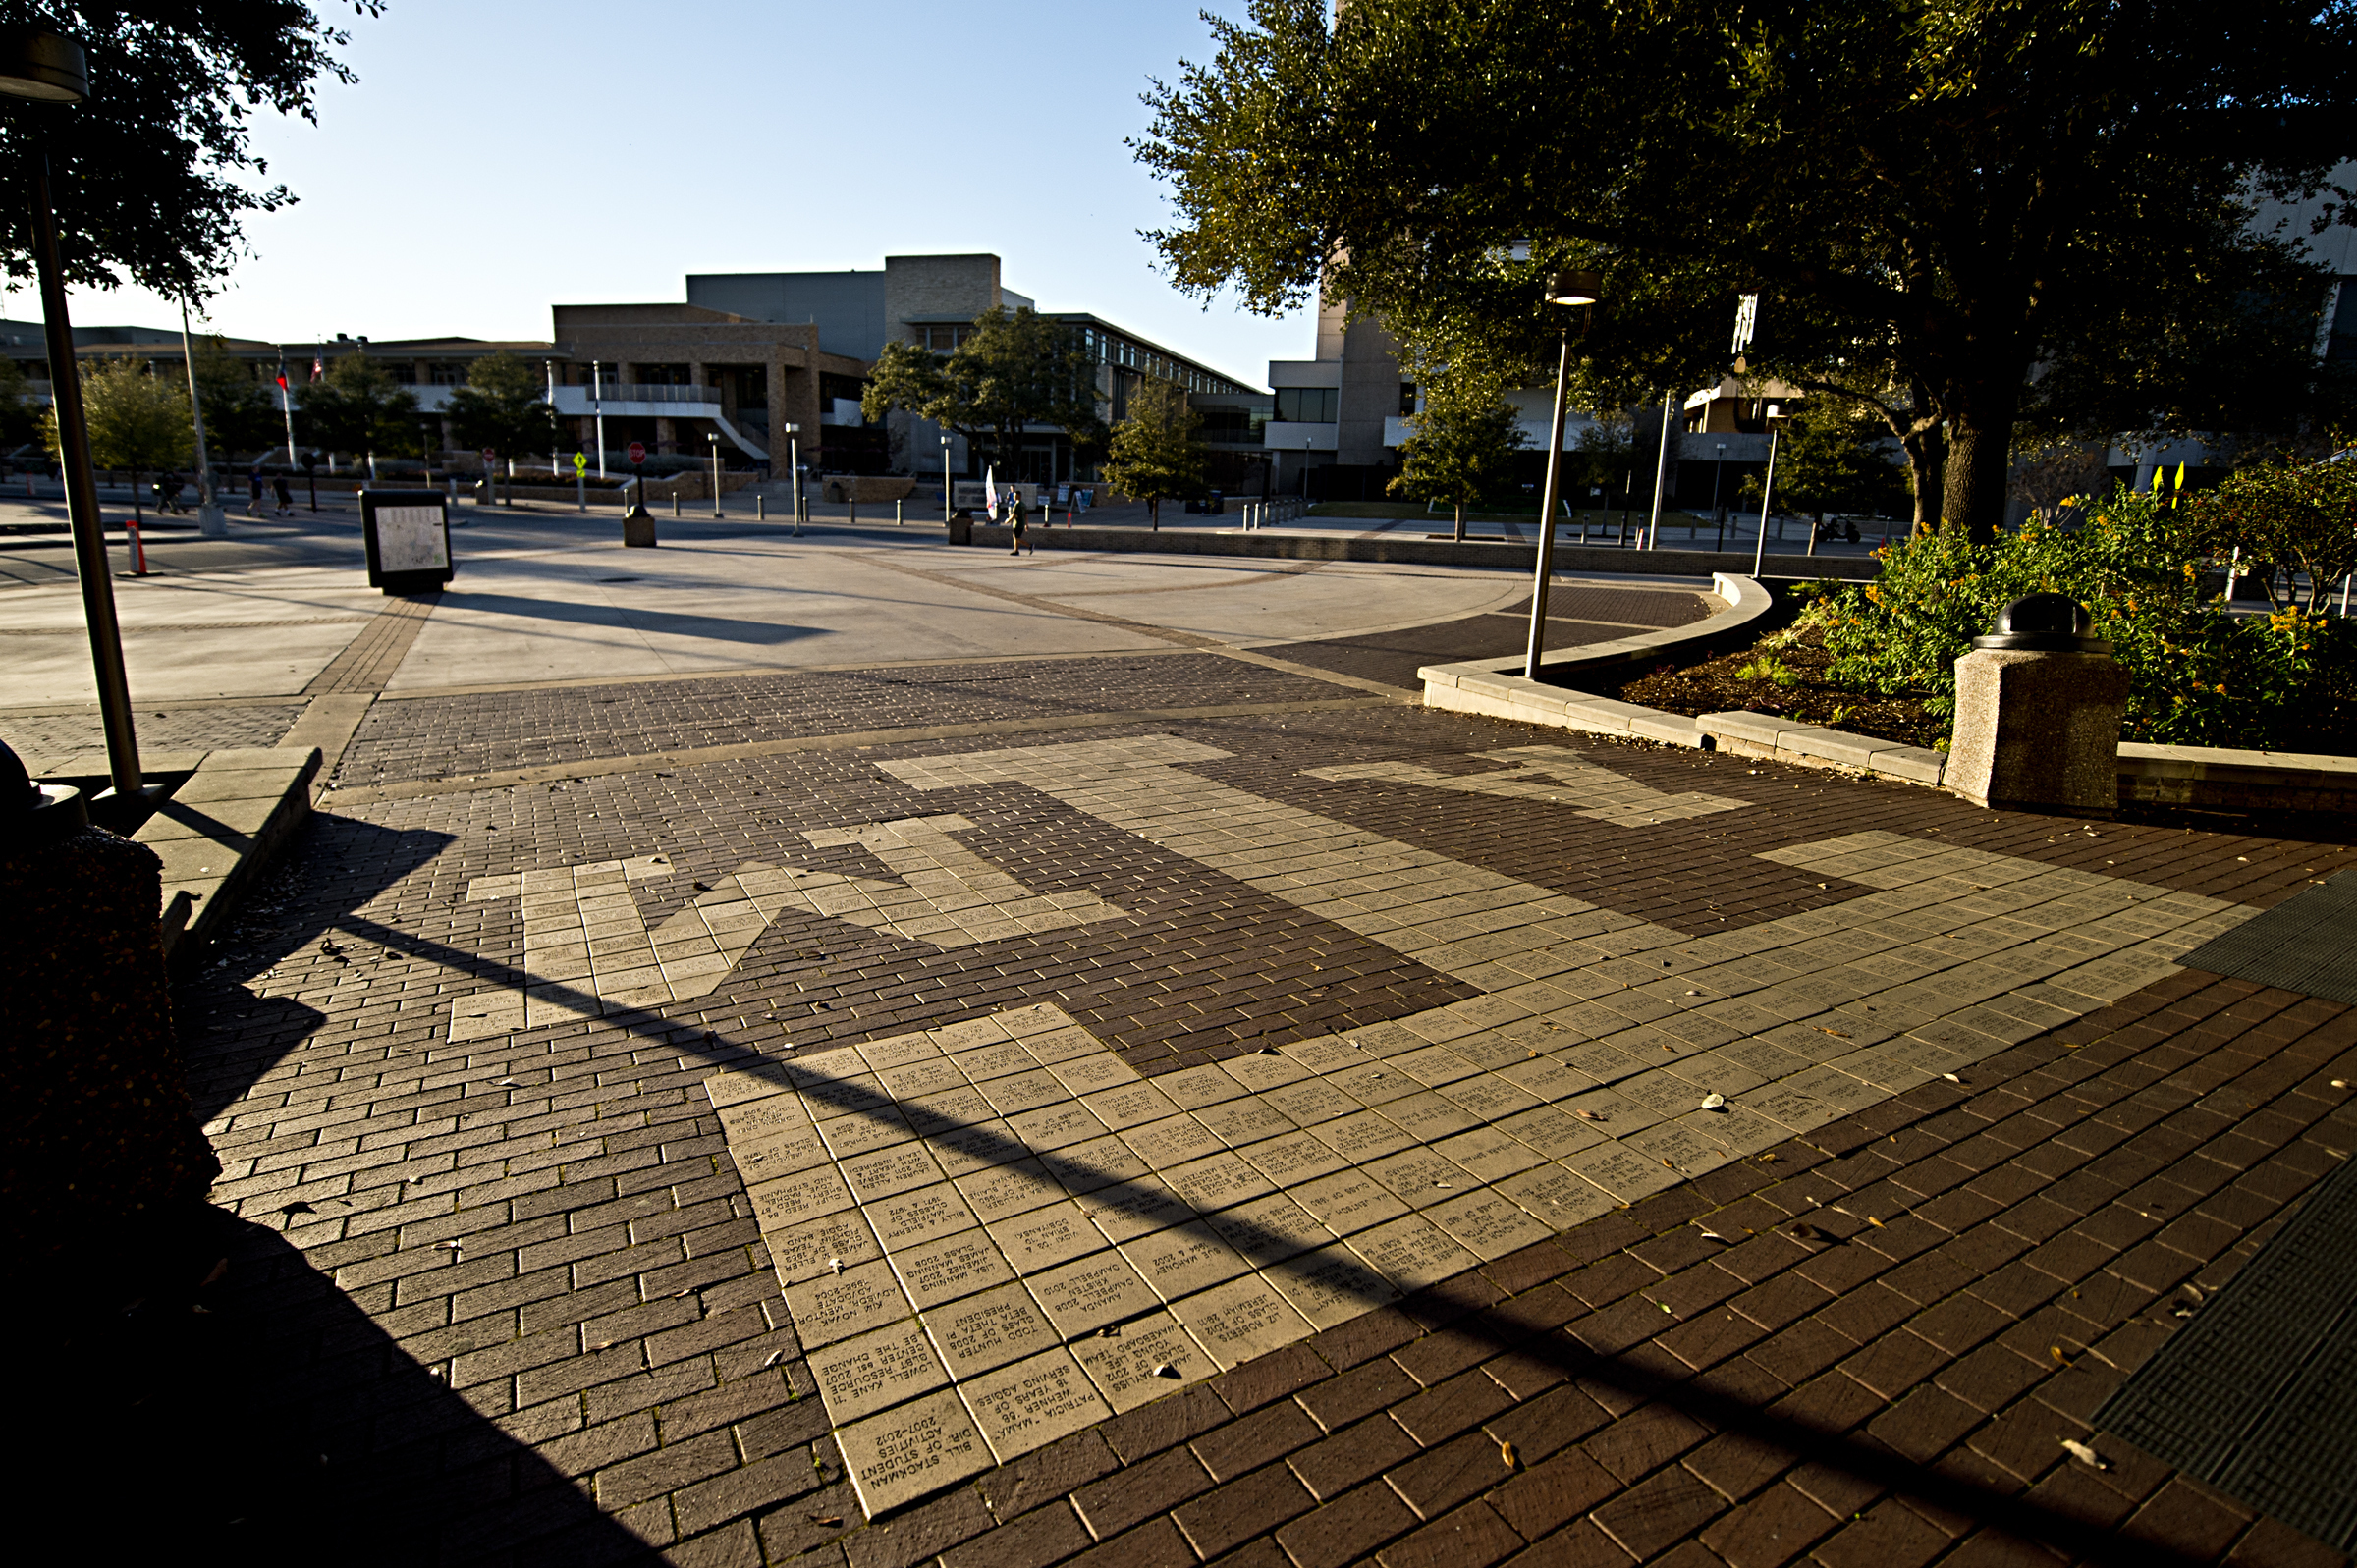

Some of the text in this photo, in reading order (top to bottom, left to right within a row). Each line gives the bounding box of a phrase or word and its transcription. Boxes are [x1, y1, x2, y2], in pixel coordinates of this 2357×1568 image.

[896, 1149, 922, 1161] LEAVE
[900, 1156, 921, 1166] WITH
[861, 1166, 930, 1190] LAUREN ALLEN
[867, 1162, 896, 1175] HEART
[893, 1165, 912, 1174] 2011
[758, 1174, 833, 1201] AND STEPHANIE
[764, 1190, 801, 1205] RACHEL
[806, 1185, 842, 1200] SHERYL
[814, 1193, 841, 1206] CLIFF
[1139, 1186, 1166, 1199] JASON
[776, 1197, 801, 1210] REED
[784, 1202, 809, 1214] REED
[888, 1205, 907, 1216] 1972
[889, 1201, 948, 1223] CLASSES OF
[922, 1195, 941, 1205] 1971
[1107, 1199, 1176, 1225] SANDRA ERWIN
[1135, 1197, 1159, 1208] MOM
[899, 1209, 945, 1227] MAYFIELD
[940, 1210, 965, 1222] BILLY
[786, 1222, 849, 1246] AGGIE BAND
[831, 1234, 862, 1249] CLASS
[886, 1222, 924, 1239] SHERRY
[1023, 1225, 1069, 1245] BRIAN '10
[1054, 1230, 1080, 1243] VICKI
[781, 1241, 813, 1255] TEXAS
[812, 1245, 826, 1255] OF
[835, 1240, 868, 1255] JAMES
[913, 1243, 974, 1267] CLASS 2008
[1187, 1241, 1209, 1253] 1994
[783, 1256, 816, 1271] ELLER
[905, 1246, 990, 1278] JAMES MANNING
[918, 1256, 988, 1283] JIMENEZ 2007
[1151, 1253, 1176, 1266] 2002
[1153, 1246, 1221, 1275] SUE MAHONEY
[920, 1262, 996, 1292] LISA MANNING
[1042, 1263, 1120, 1295] CAMPBELL 2010
[1067, 1276, 1109, 1297] KRISTEN
[816, 1285, 872, 1309] ADVOCATE
[1053, 1277, 1134, 1312] CAMPBELL 2008
[1079, 1292, 1122, 1313] AMANDA
[1221, 1293, 1269, 1317] JEREMIAH
[796, 1304, 844, 1325] MENTOR
[820, 1300, 883, 1326] KIM NOVAK
[944, 1306, 1027, 1340] BETA THETA PI
[954, 1302, 1011, 1327] PRESIDENT
[1203, 1301, 1279, 1335] CLASS OF 2012
[948, 1314, 1035, 1350] CLASS OF 2008
[1216, 1311, 1283, 1343] LIZ ROBERTS
[879, 1342, 924, 1365] CENTER
[957, 1325, 1038, 1359] TODD HUNTER
[1082, 1324, 1175, 1367] WAKEBOARD TEAM
[1104, 1338, 1171, 1370] YOUNG LIFE
[821, 1333, 918, 1376] BE THE CHANGE
[1104, 1343, 1186, 1382] CLASS OF 2012
[824, 1369, 851, 1385] 2007
[829, 1352, 928, 1395] GLBT RESOURCE
[832, 1360, 934, 1406] LOWELL KANE '11
[1021, 1364, 1070, 1388] SERVING
[1111, 1352, 1196, 1392] JAM BAYLISS
[993, 1377, 1069, 1414] 18 YEARS OF
[1023, 1387, 1072, 1414] WEHNER
[1043, 1391, 1095, 1418] PATRICIA
[874, 1415, 936, 1446] 2007-2012
[877, 1426, 943, 1459] ACTIVITIES
[859, 1427, 972, 1481] DIR. OF STUDENT
[869, 1440, 972, 1490] BILL STACKMAN
